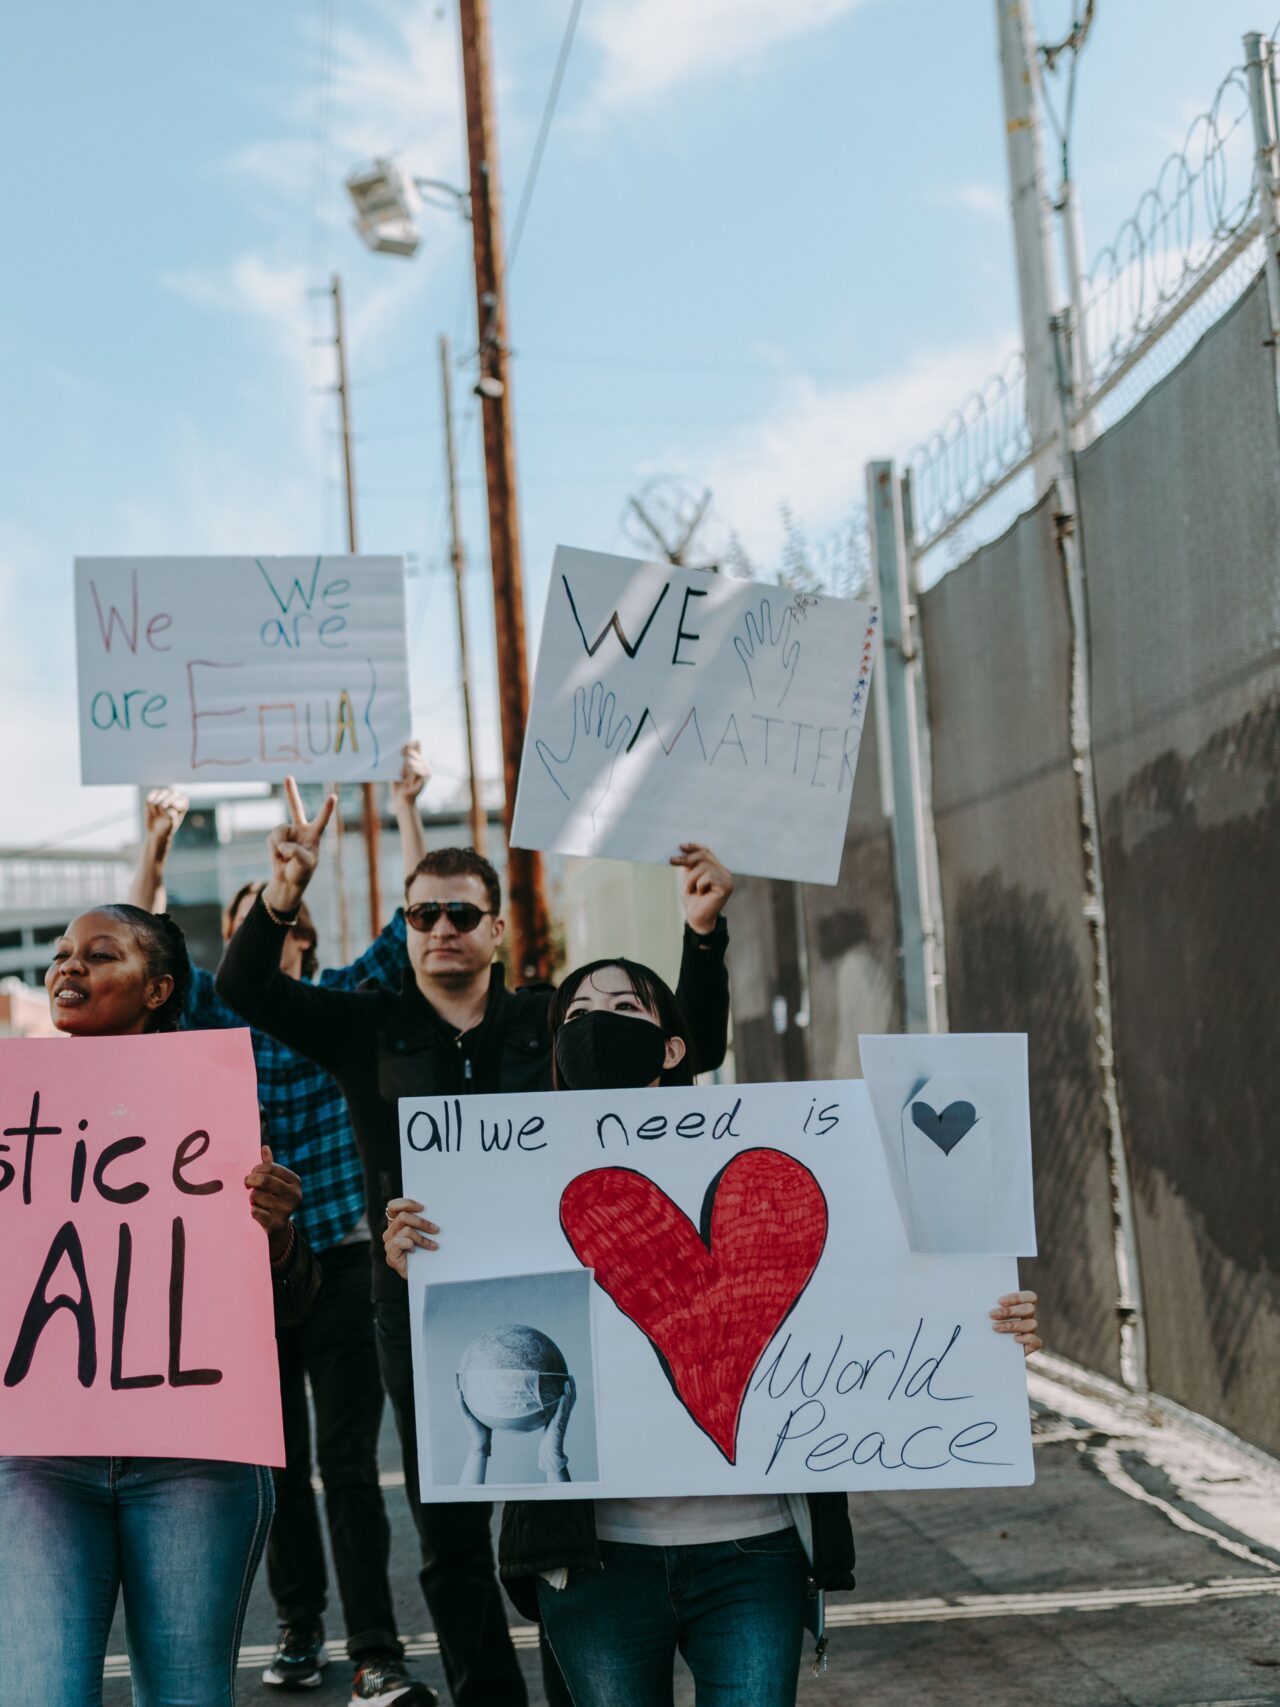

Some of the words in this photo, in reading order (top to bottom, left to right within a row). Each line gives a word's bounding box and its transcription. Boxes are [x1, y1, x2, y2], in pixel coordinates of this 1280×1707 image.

[89, 569, 173, 655] We
[255, 555, 352, 614] We
[561, 573, 708, 666] WE
[259, 613, 350, 650] are
[90, 689, 169, 730] are
[625, 705, 863, 794] MATTER
[406, 1098, 462, 1153] all
[479, 1112, 549, 1152] we
[595, 1098, 743, 1148] need
[802, 1097, 841, 1136] is
[3, 1216, 224, 1391] ALL
[753, 1317, 976, 1402] World
[764, 1399, 1016, 1477] Peace
